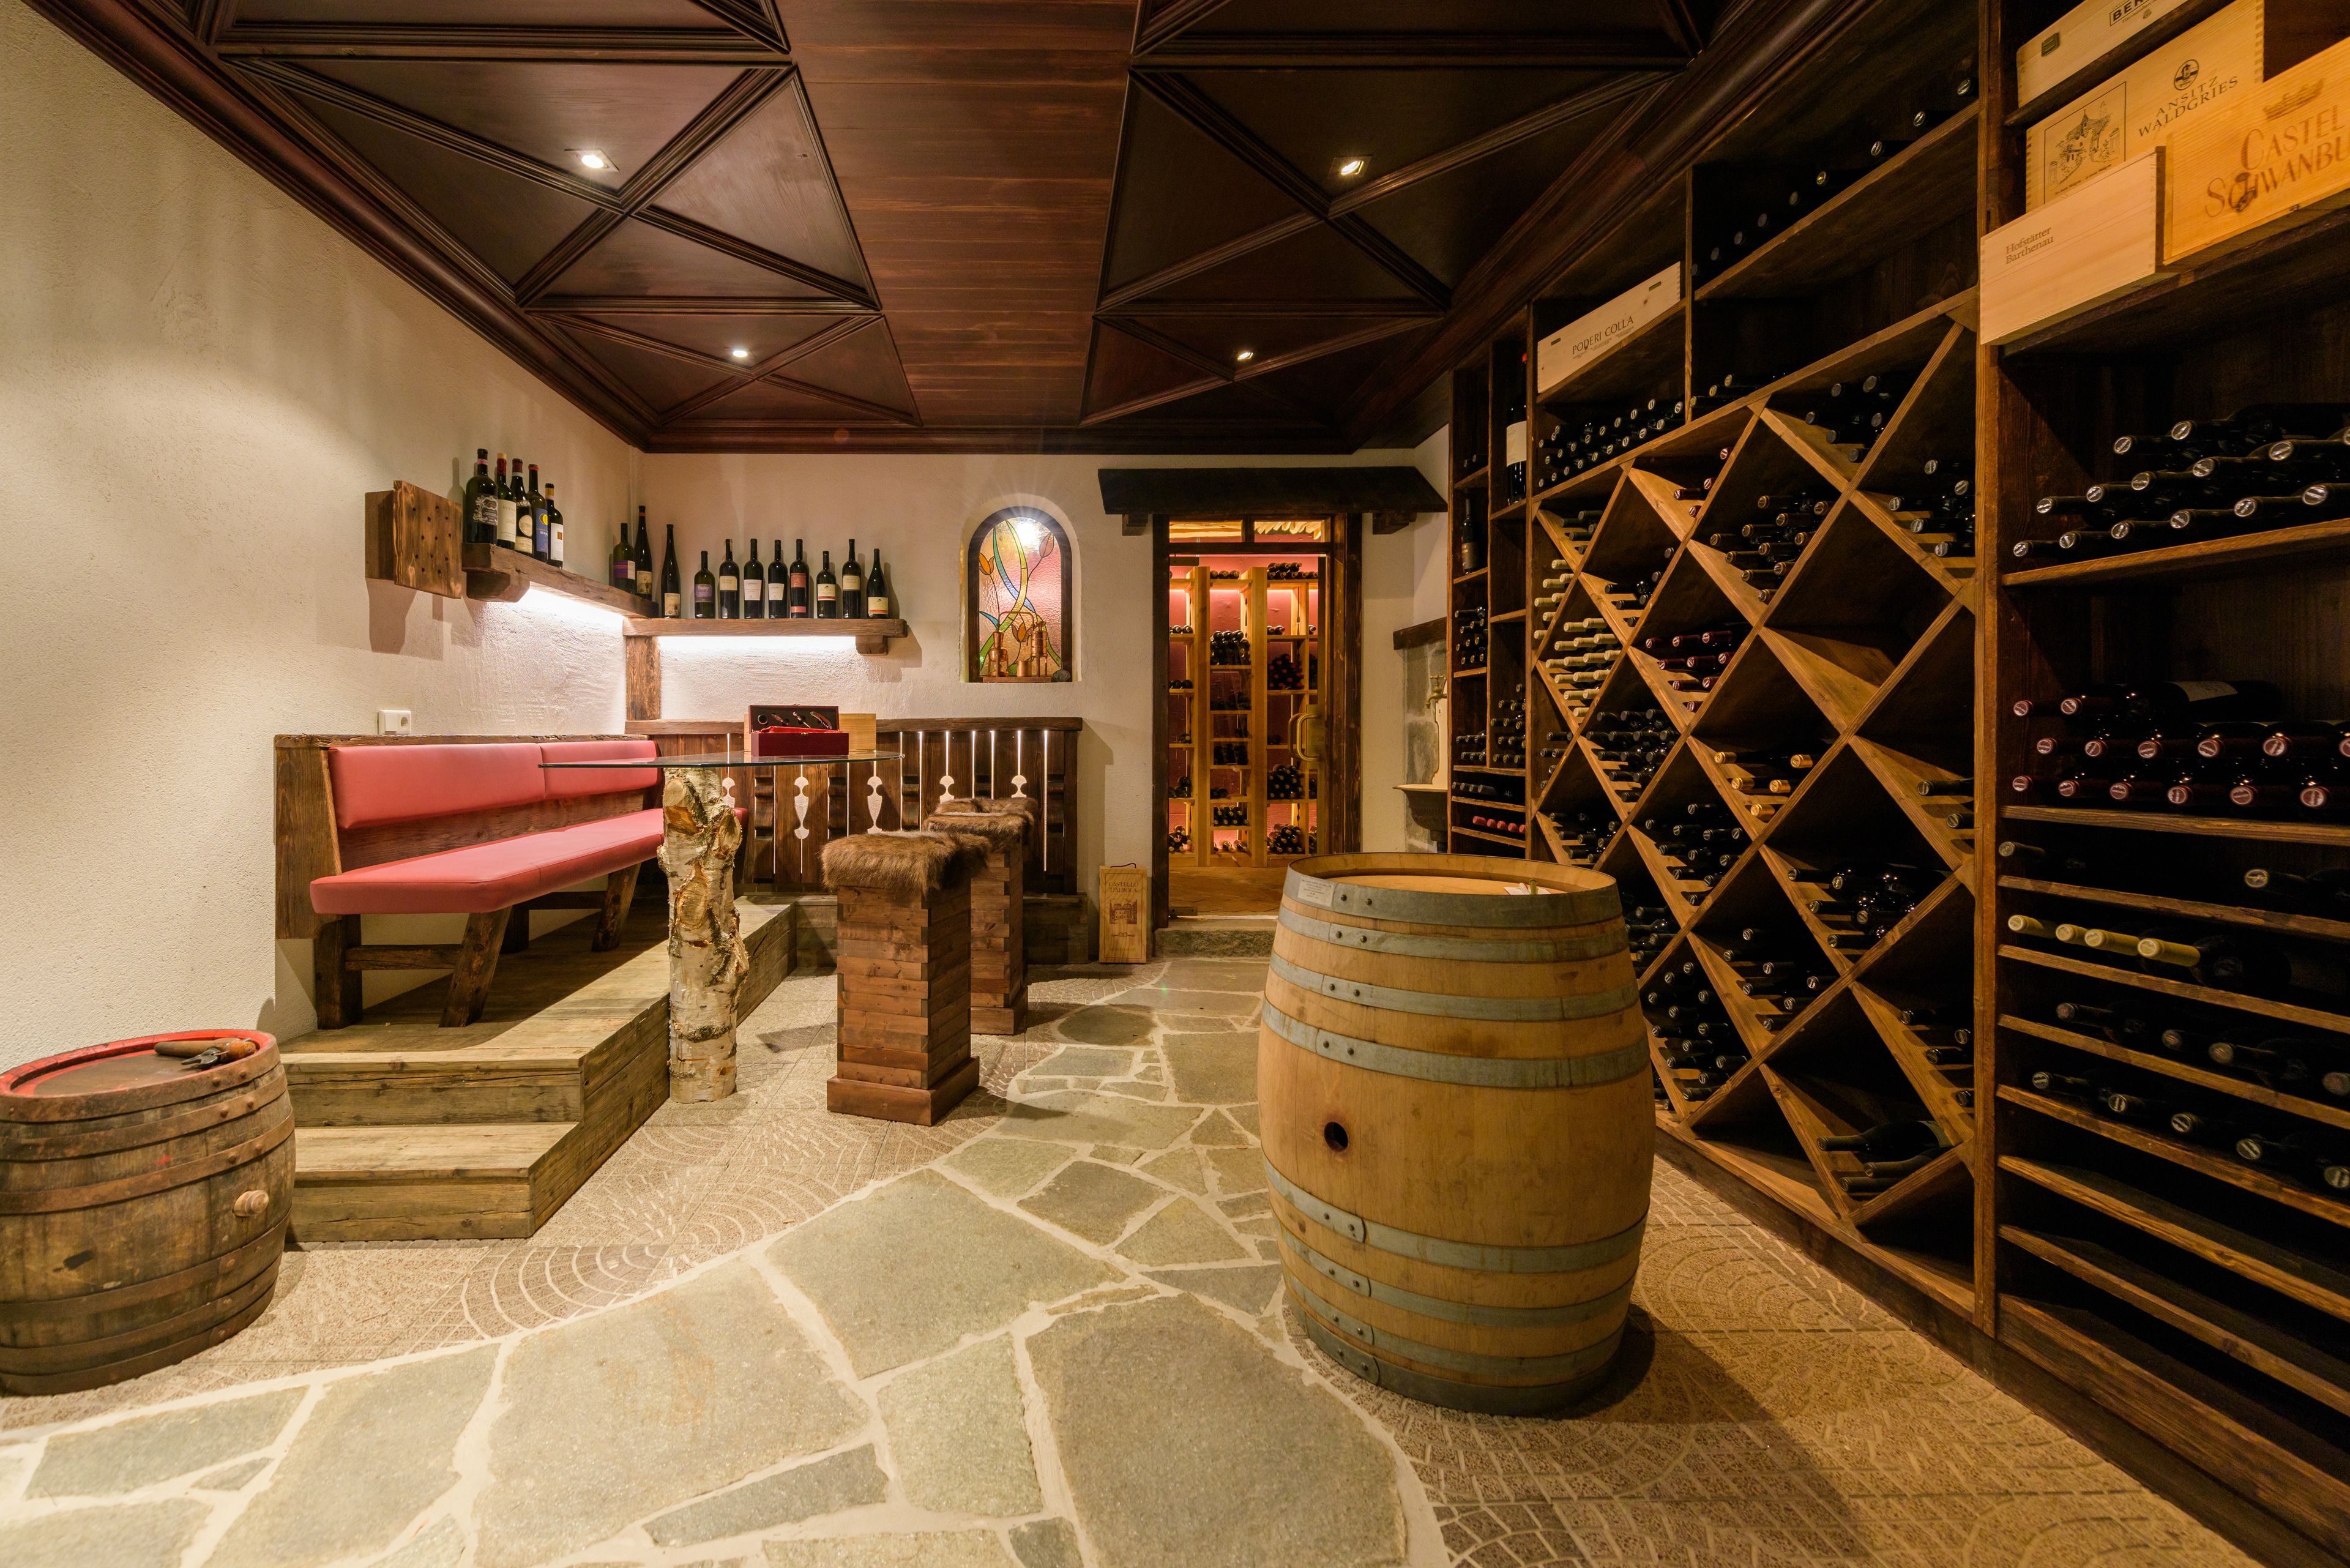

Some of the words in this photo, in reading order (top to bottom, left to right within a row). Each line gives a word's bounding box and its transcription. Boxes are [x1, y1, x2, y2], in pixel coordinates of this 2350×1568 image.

[2138, 76, 2238, 136] WALDGRIES
[2156, 76, 2218, 117] ANSITZ
[2240, 105, 2345, 170] CASTEL
[2005, 227, 2051, 255] Hofstätter
[2005, 236, 2054, 264] Barthenau
[1572, 331, 1602, 354] PODERI
[1605, 315, 1633, 337] COLLA
